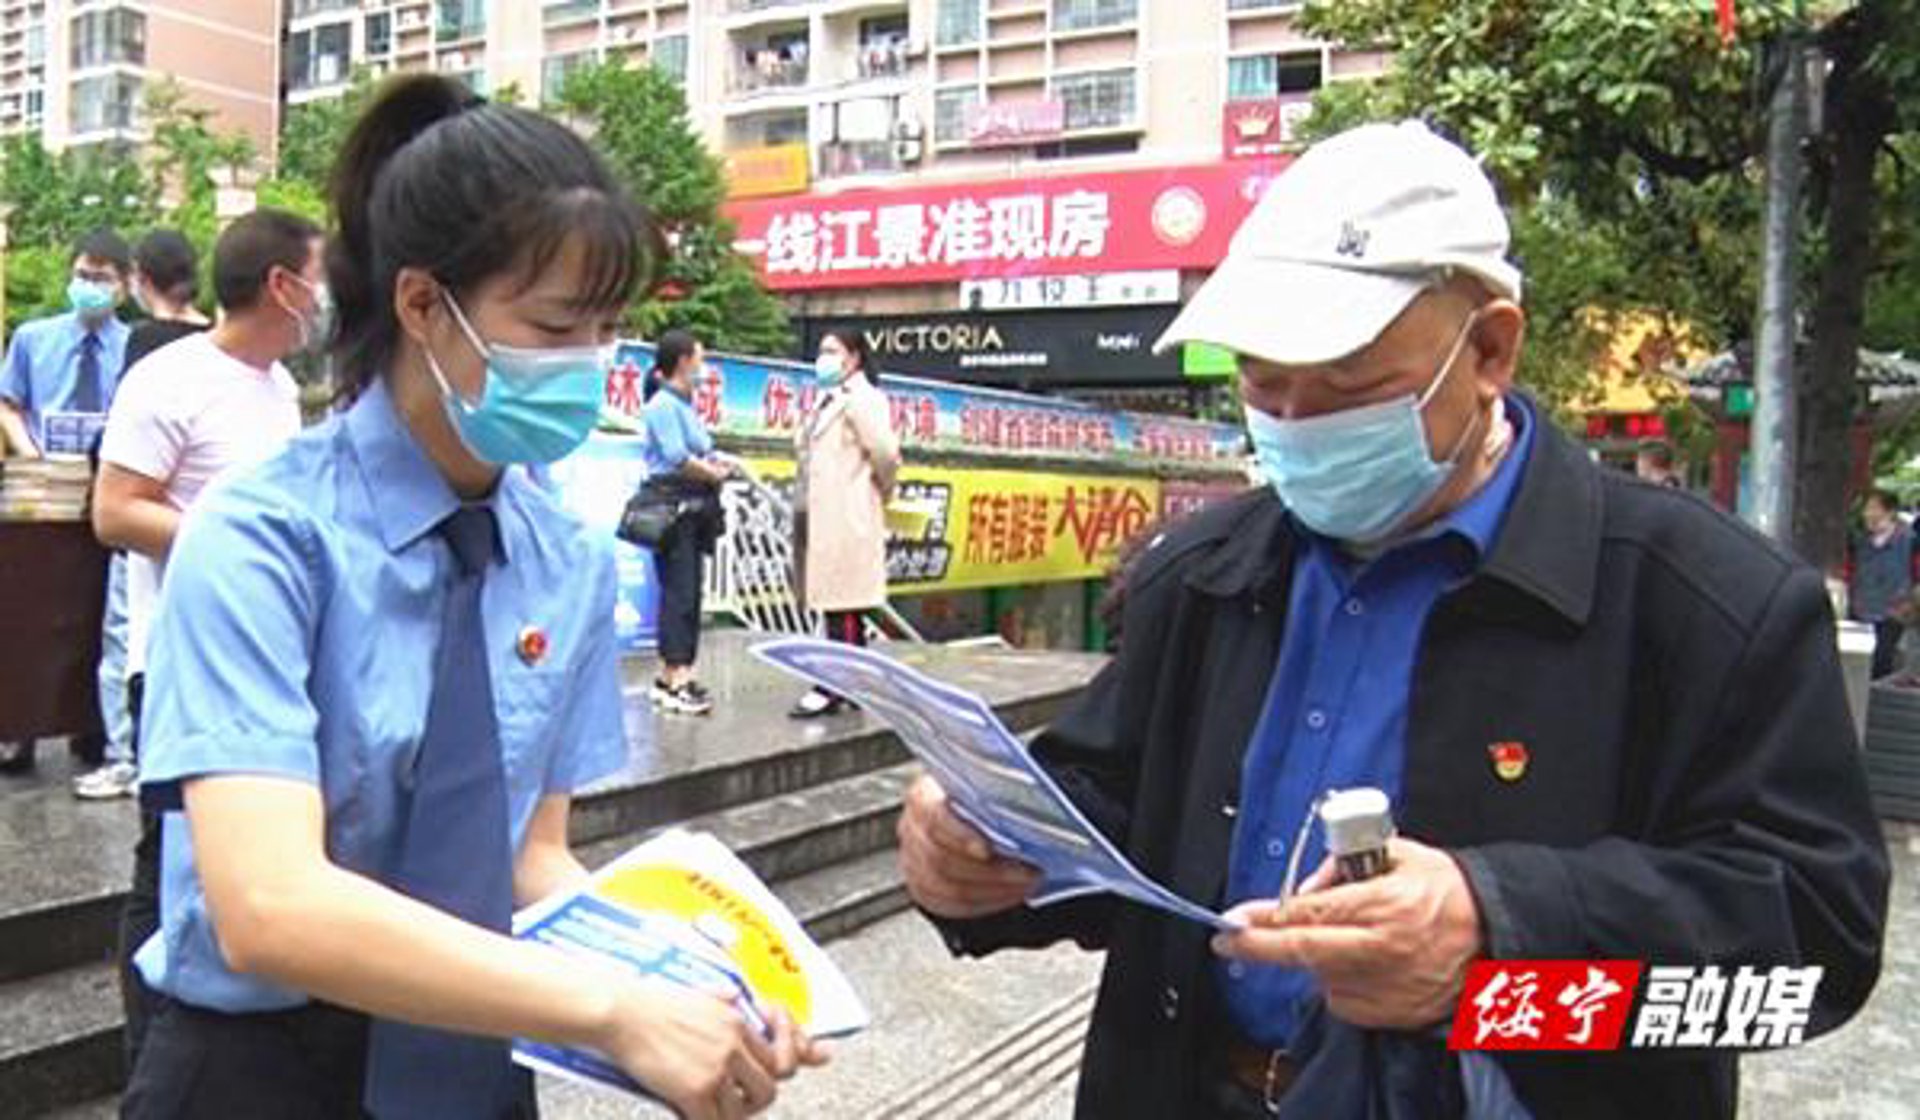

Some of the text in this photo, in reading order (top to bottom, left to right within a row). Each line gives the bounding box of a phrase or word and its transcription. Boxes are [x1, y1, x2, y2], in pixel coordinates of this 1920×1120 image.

[731, 190, 1110, 274] 一线江景准现房
[863, 324, 1004, 352] VICTORIA
